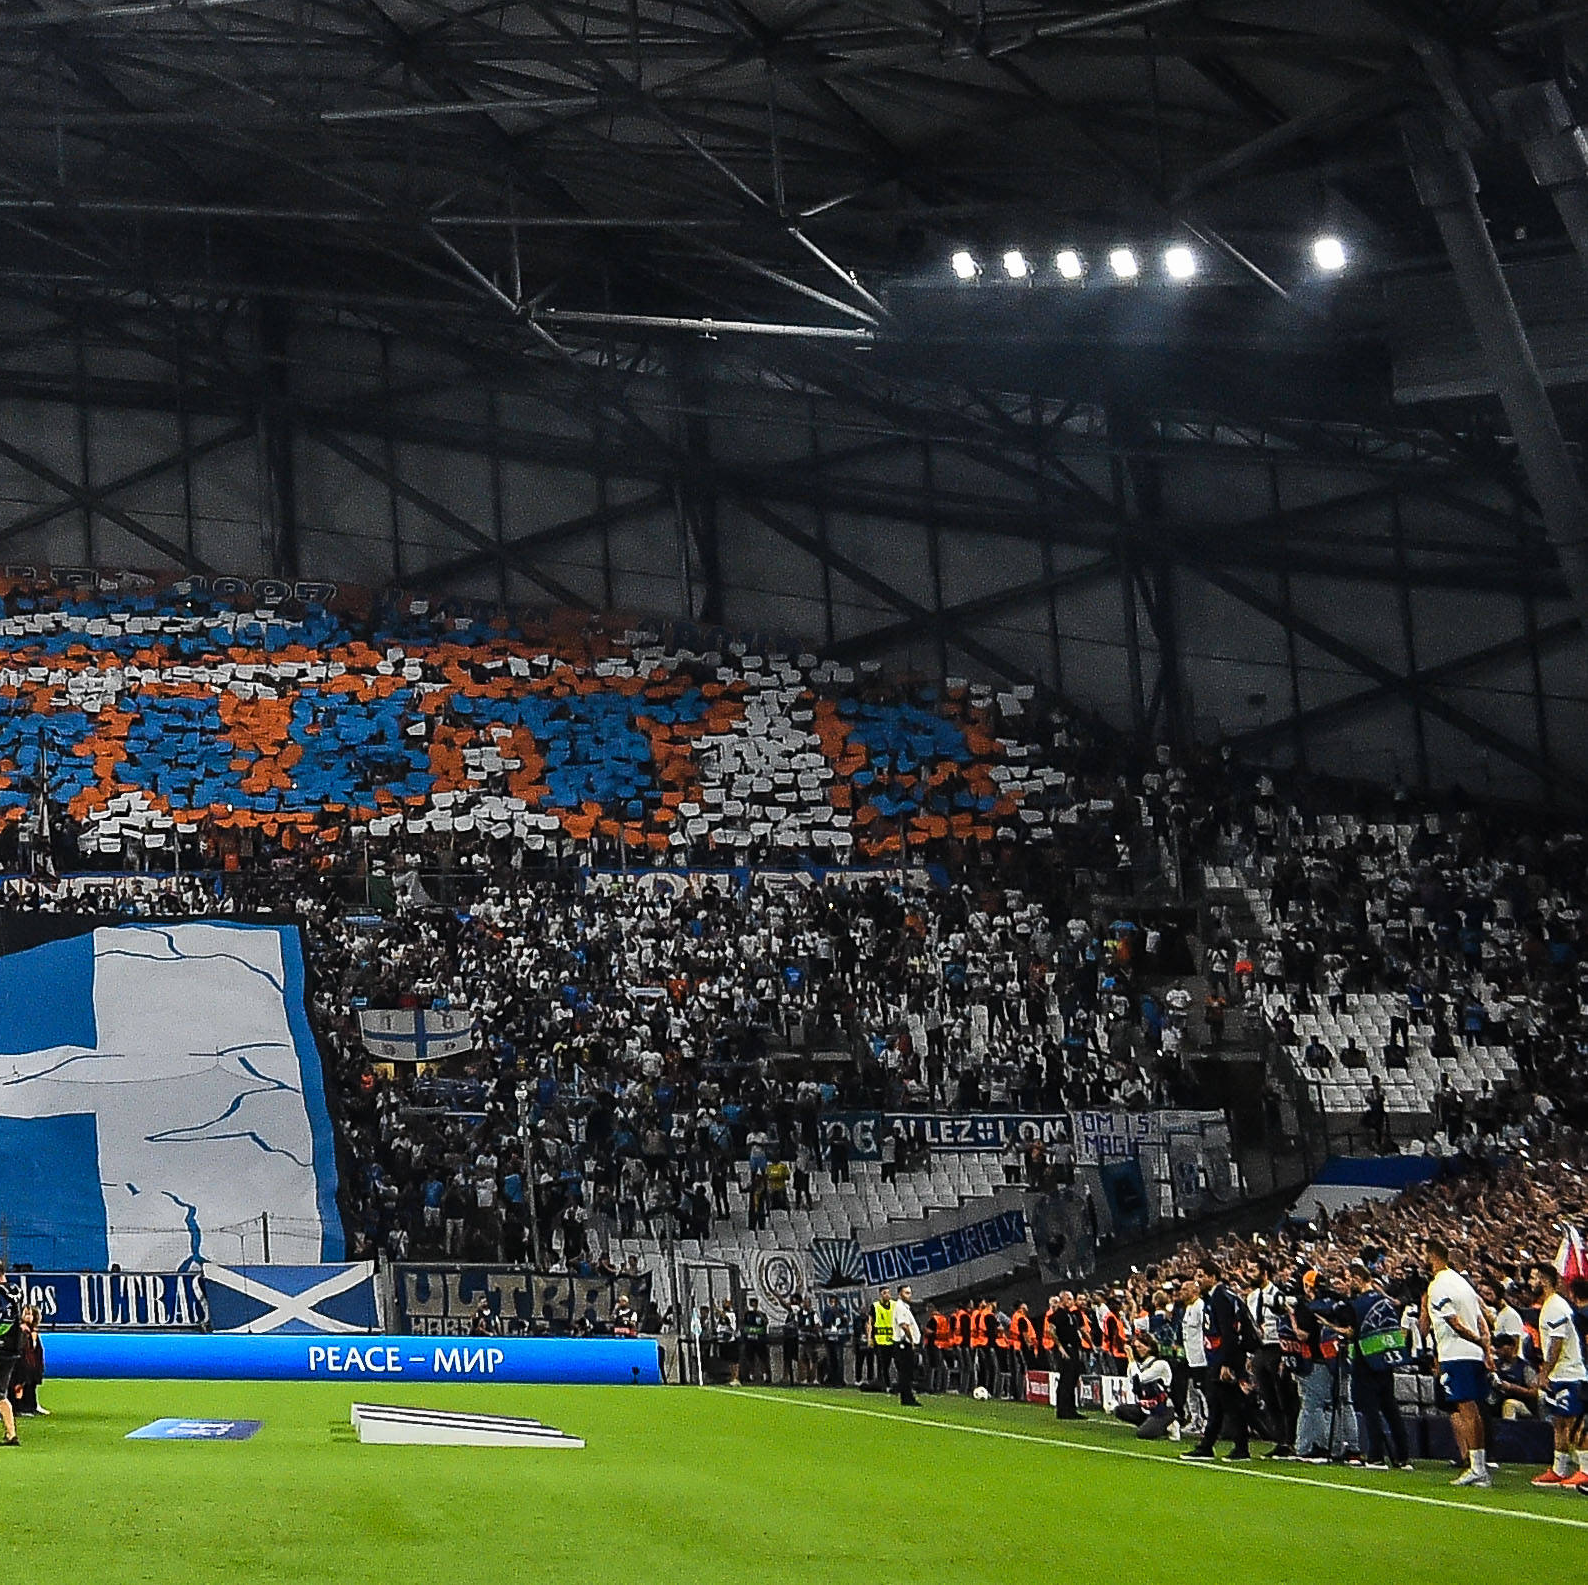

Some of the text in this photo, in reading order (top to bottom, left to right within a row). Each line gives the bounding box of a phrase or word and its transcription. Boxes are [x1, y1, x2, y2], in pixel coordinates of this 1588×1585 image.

[891, 1118, 975, 1144] ALLEZ
[79, 1274, 210, 1324] ULTRAS
[307, 1345, 403, 1373] PEACE
